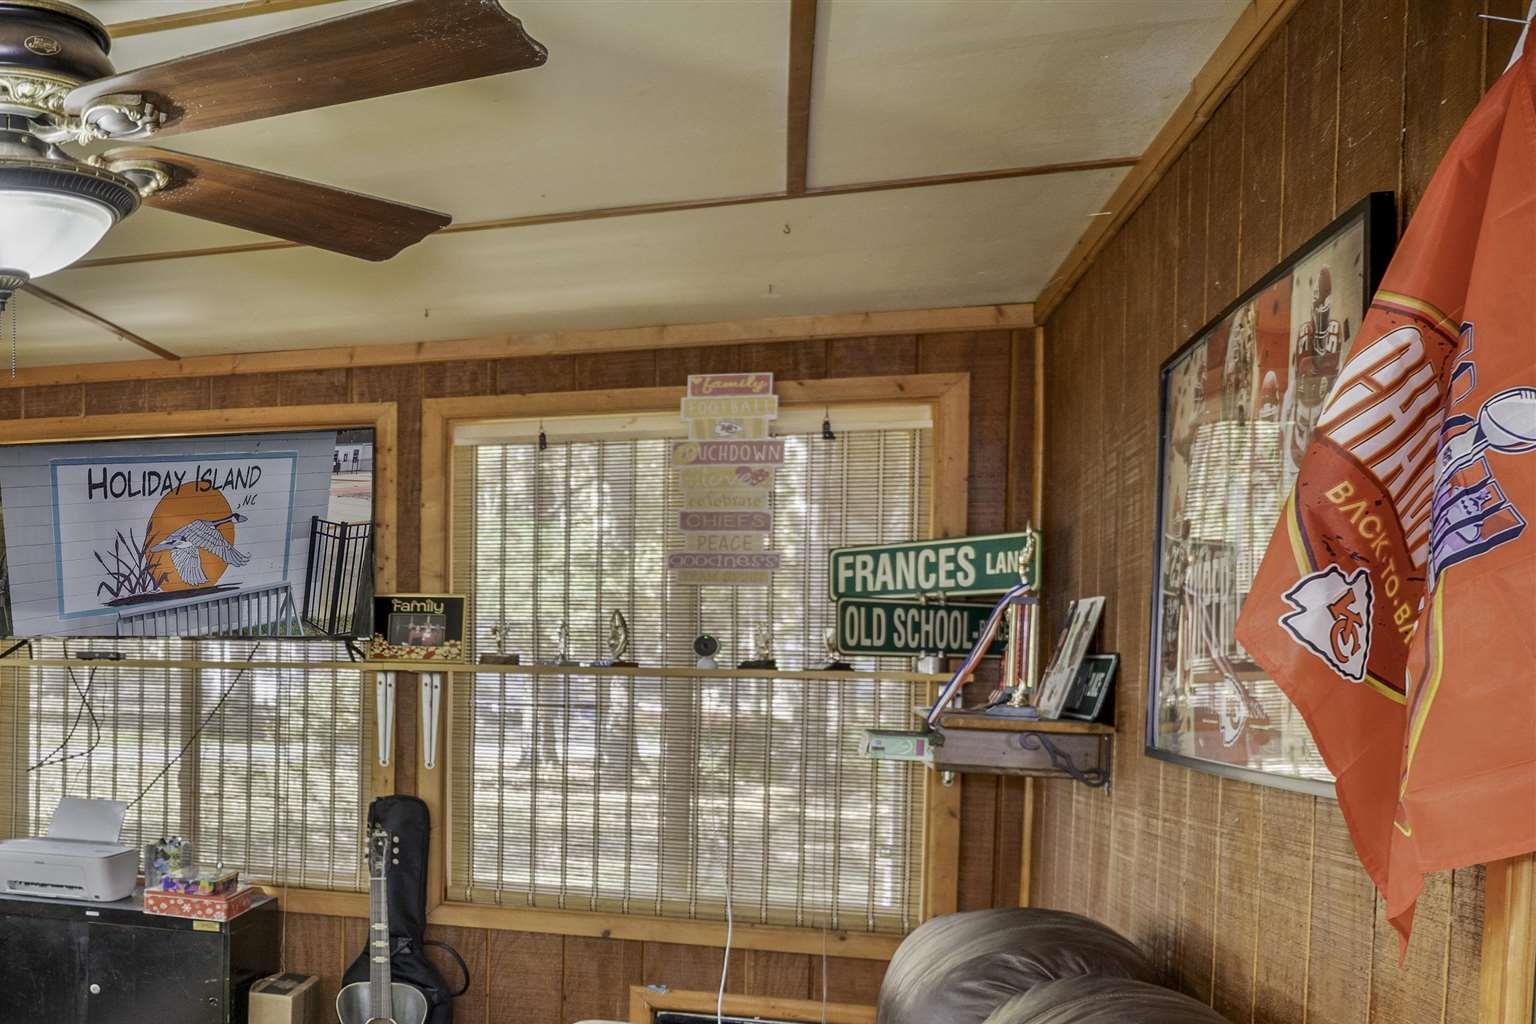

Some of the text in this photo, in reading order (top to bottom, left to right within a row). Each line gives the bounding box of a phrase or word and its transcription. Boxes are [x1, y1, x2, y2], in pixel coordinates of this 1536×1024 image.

[702, 375, 767, 395] family
[88, 464, 263, 500] HOLIDAY ISLAND
[686, 513, 767, 528] CHIEFS
[696, 534, 753, 552] PEACE
[670, 553, 779, 569] goodness
[838, 545, 1027, 593] FRANCES LAN
[392, 598, 445, 614] Family
[844, 605, 887, 648] OLD
[893, 607, 974, 650] SCHOOL
